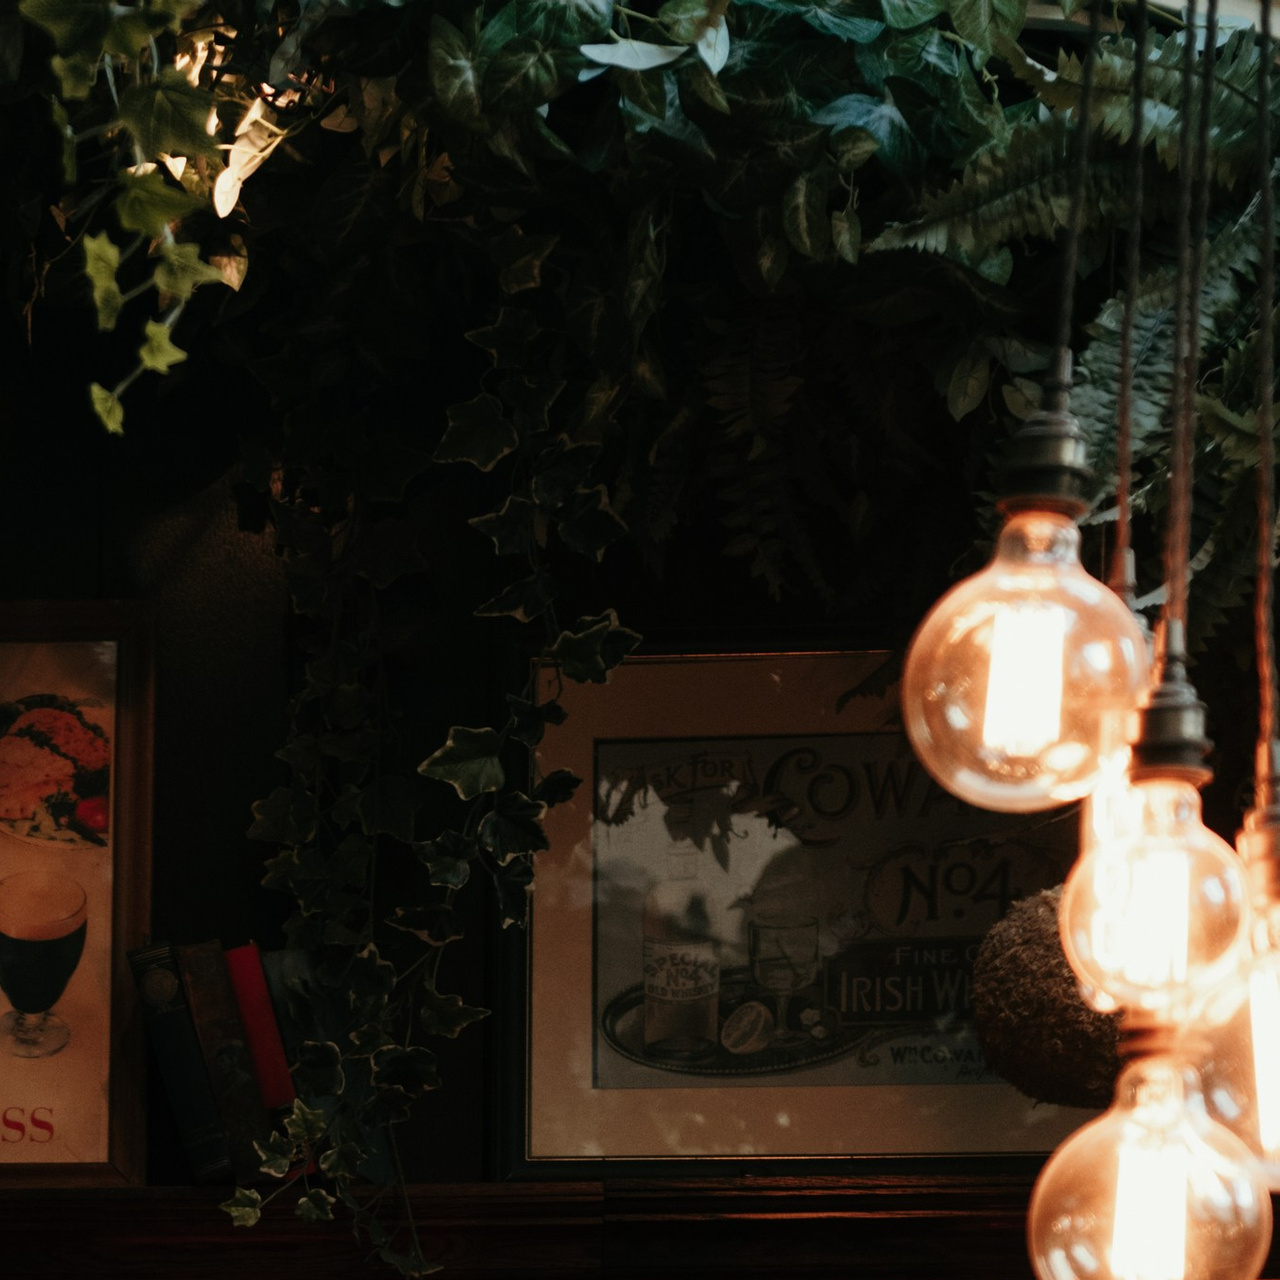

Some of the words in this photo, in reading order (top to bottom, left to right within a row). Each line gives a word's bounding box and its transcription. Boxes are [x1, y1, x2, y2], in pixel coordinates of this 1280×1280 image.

[686, 750, 740, 791] FOR
[889, 945, 958, 966] FINE
[840, 970, 924, 1014] IRISH
